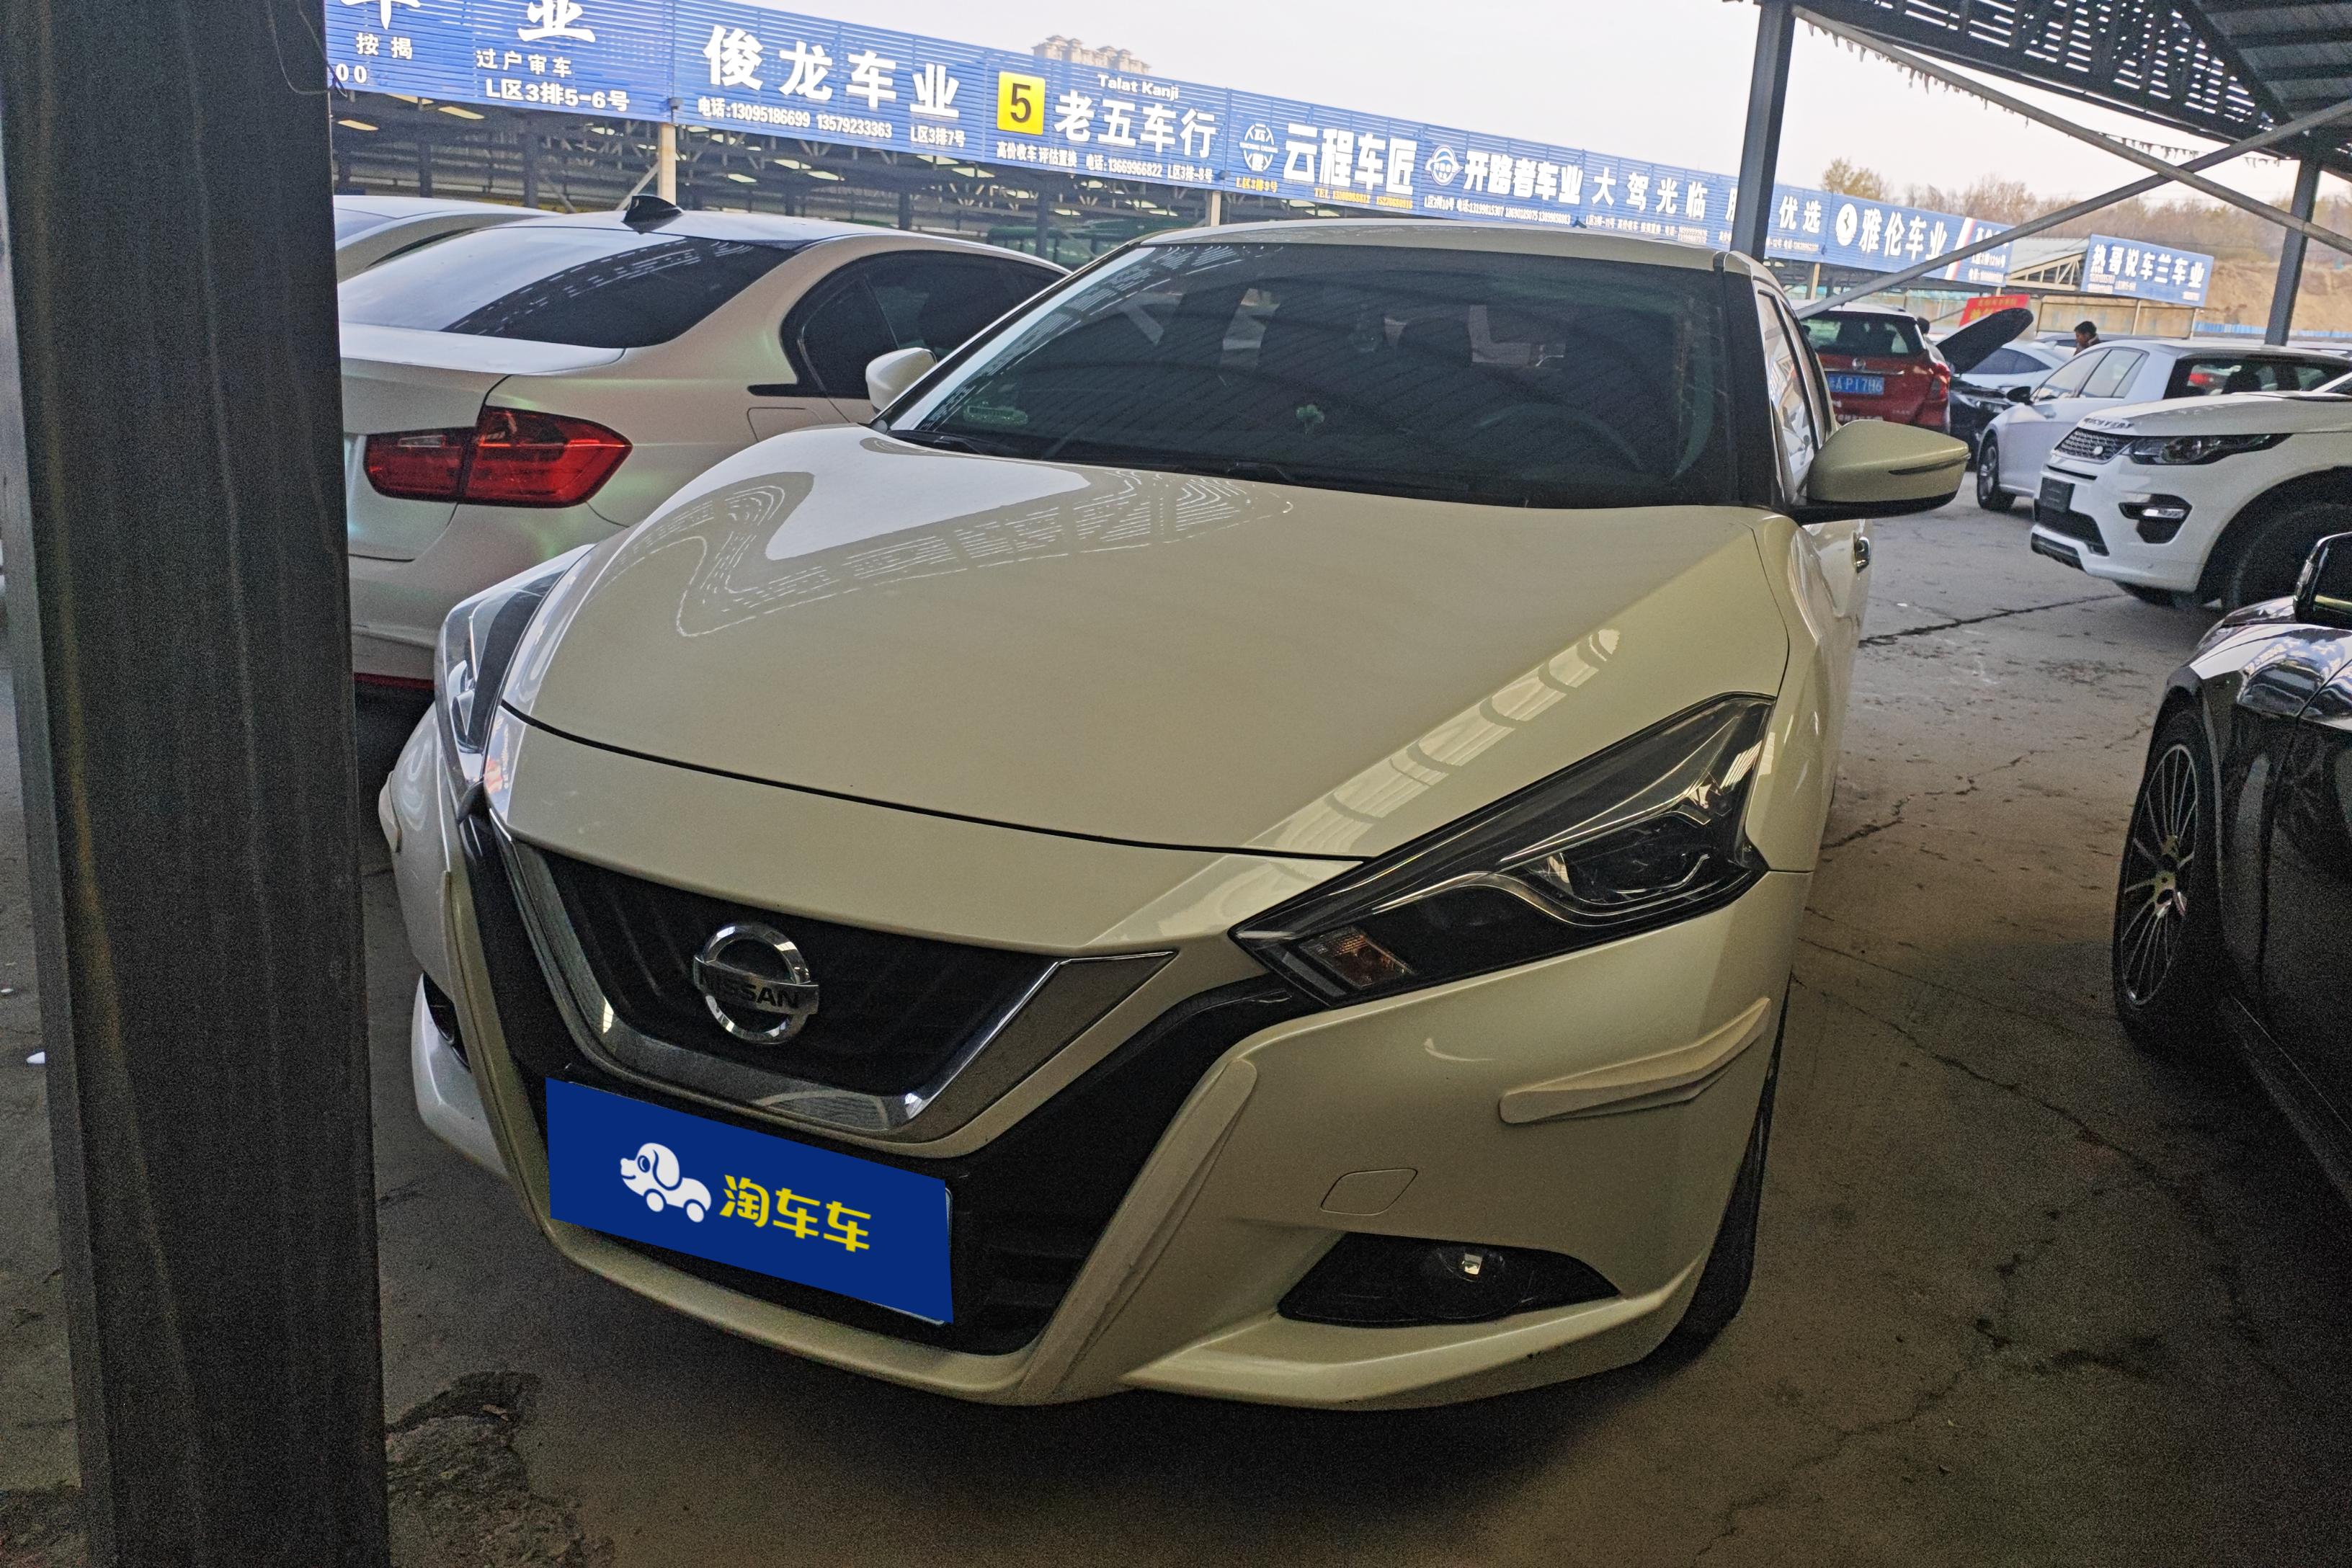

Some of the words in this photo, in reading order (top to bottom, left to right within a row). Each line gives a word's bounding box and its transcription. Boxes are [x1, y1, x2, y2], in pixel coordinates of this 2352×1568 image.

[356, 32, 413, 59] 按揭
[476, 48, 573, 78] 过户审车
[703, 24, 961, 118] 俊龙车业
[1097, 74, 1138, 93] Talat
[1141, 81, 1180, 102] Kanji
[486, 79, 631, 112] L区3排5-6号
[1010, 83, 1031, 123] 5
[910, 125, 966, 148] L区3排7号
[1054, 89, 1218, 159] 老五车行
[1283, 122, 1418, 195] 云程车匠
[1464, 149, 1584, 205] 开路者车业
[1591, 166, 1708, 220] 大驾光临
[1859, 208, 1948, 262] 雅伦车业
